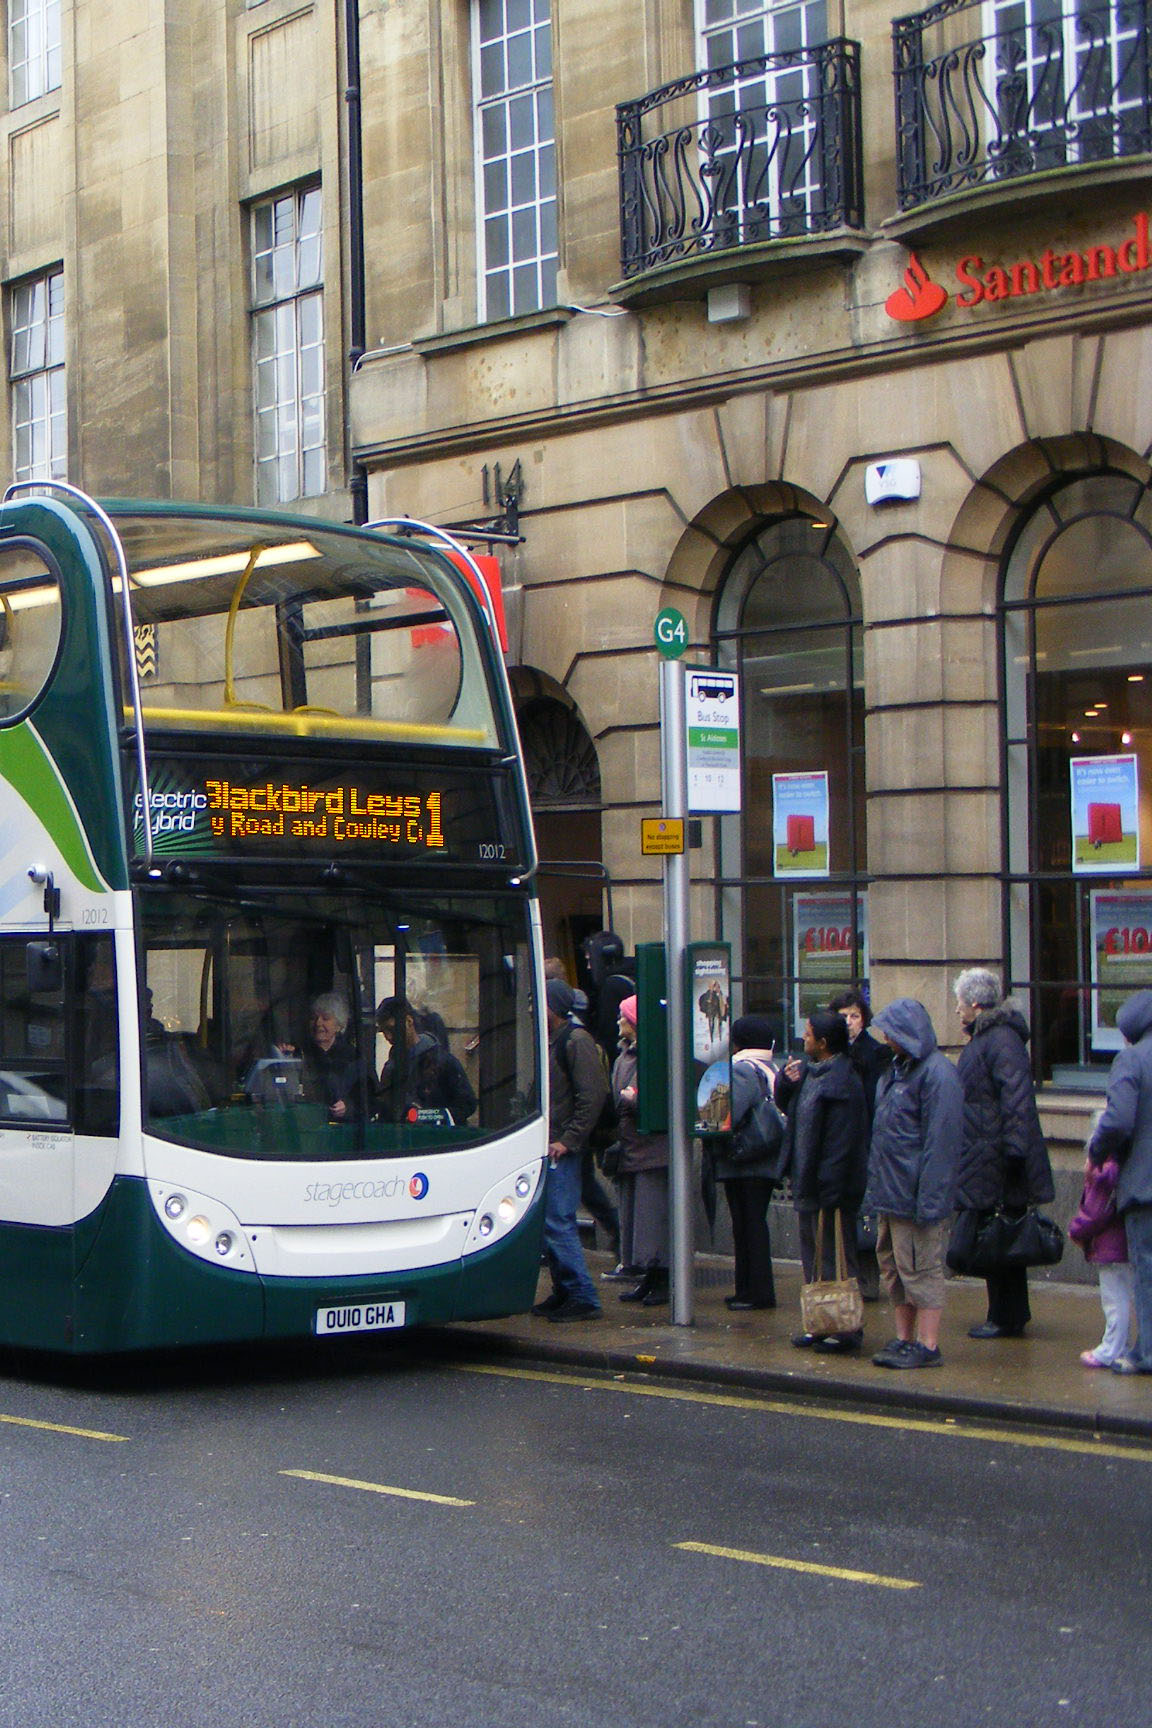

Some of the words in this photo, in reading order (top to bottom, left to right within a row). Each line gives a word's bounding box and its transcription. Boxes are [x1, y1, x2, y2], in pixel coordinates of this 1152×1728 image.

[955, 211, 1152, 308] Santand
[657, 617, 686, 644] G4
[697, 710, 711, 722] Bus
[712, 711, 730, 725] Stop
[134, 787, 208, 809] electric
[350, 787, 421, 818] Leys
[231, 811, 284, 837] Road
[291, 815, 328, 838] and
[334, 816, 401, 843] Cowley
[406, 819, 424, 843] C
[425, 791, 445, 848] 1
[477, 843, 507, 860] 12012
[80, 908, 109, 925] 12012
[1103, 926, 1152, 955] £10
[304, 1176, 406, 1207] stagecoach
[326, 1307, 362, 1330] OU10
[365, 1305, 396, 1327] GHA
